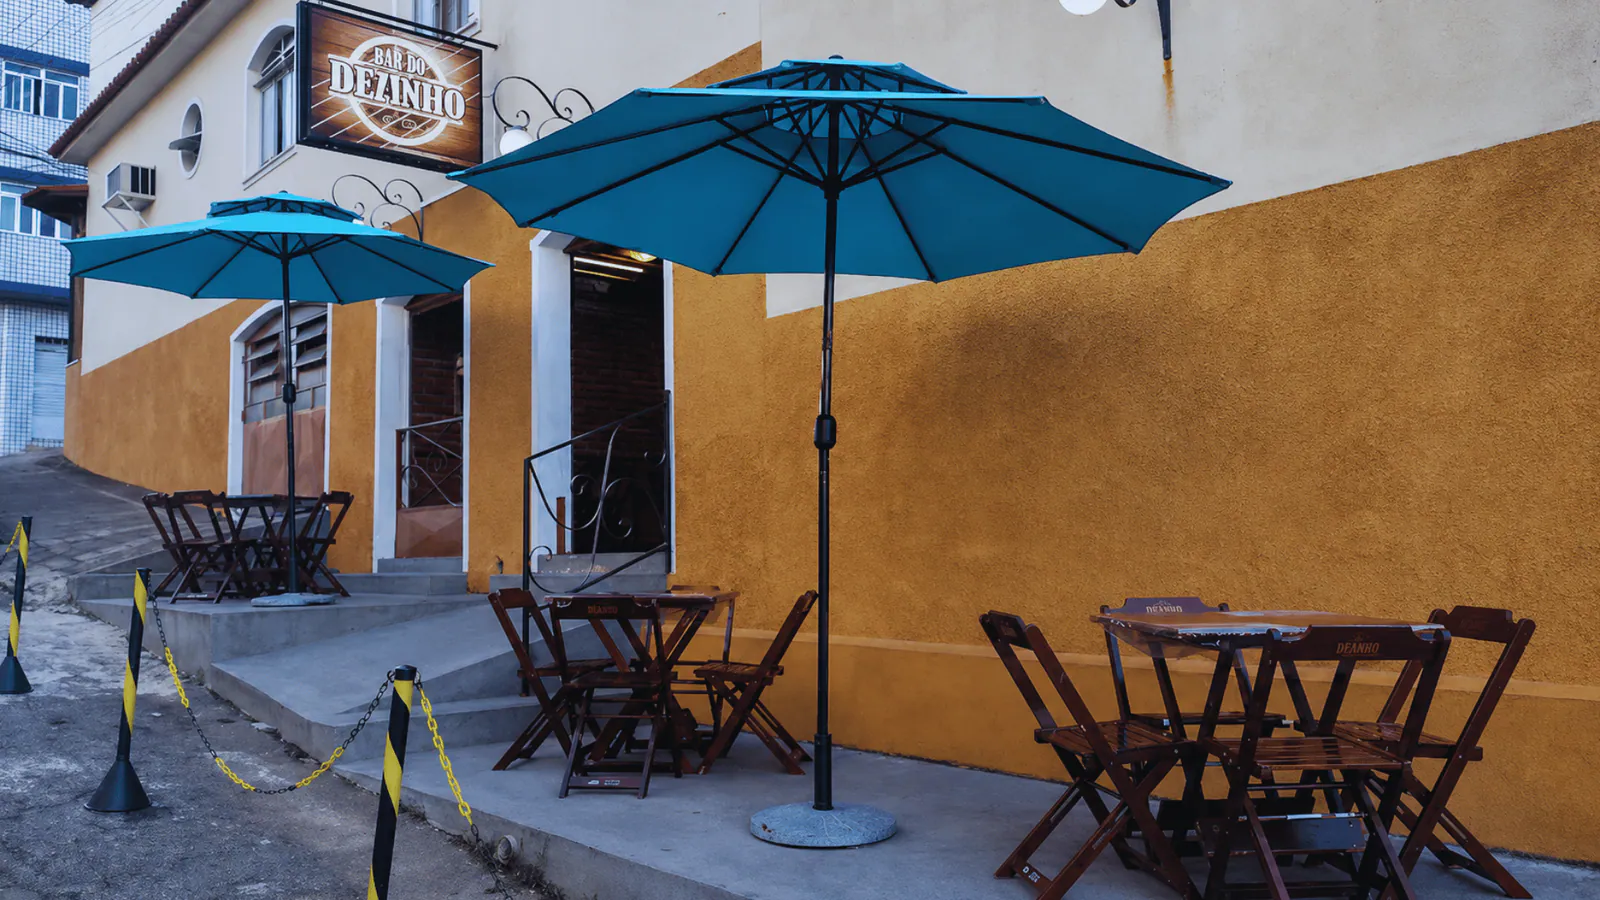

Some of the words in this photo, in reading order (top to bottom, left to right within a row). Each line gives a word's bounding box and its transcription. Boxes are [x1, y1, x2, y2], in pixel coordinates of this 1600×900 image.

[374, 47, 404, 73] BAR
[407, 53, 425, 76] DO
[329, 59, 466, 120] DEZINHO
